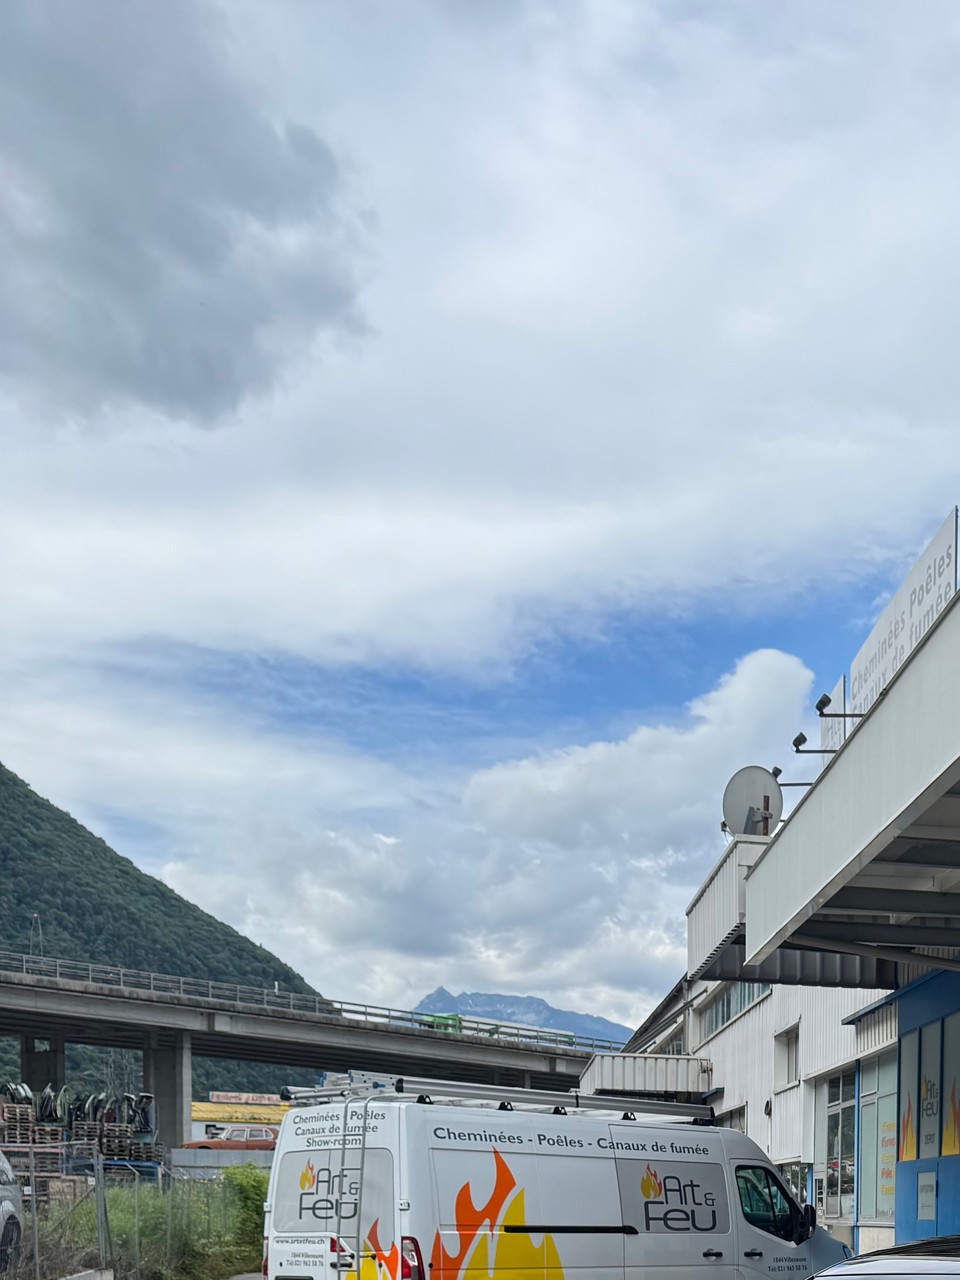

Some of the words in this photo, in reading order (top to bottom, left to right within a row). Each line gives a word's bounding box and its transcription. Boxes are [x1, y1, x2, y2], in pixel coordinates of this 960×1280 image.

[851, 610, 905, 701] Cheminées
[909, 544, 952, 619] Poêles
[891, 644, 905, 671] de
[909, 581, 951, 650] fumée
[293, 1112, 340, 1125] Cheminées
[350, 1110, 386, 1121] Poêles
[295, 1126, 326, 1136] Canaux
[328, 1124, 341, 1134] de
[306, 1137, 362, 1148] Show-room
[433, 1127, 524, 1144] Cheminées
[537, 1133, 583, 1148] Poêles
[597, 1137, 648, 1152] Canaux
[651, 1141, 667, 1153] de
[670, 1142, 709, 1155] fumée
[663, 1175, 702, 1206] Art
[704, 1192, 716, 1206] &
[299, 1192, 358, 1220] Feu
[644, 1200, 717, 1231] Feu
